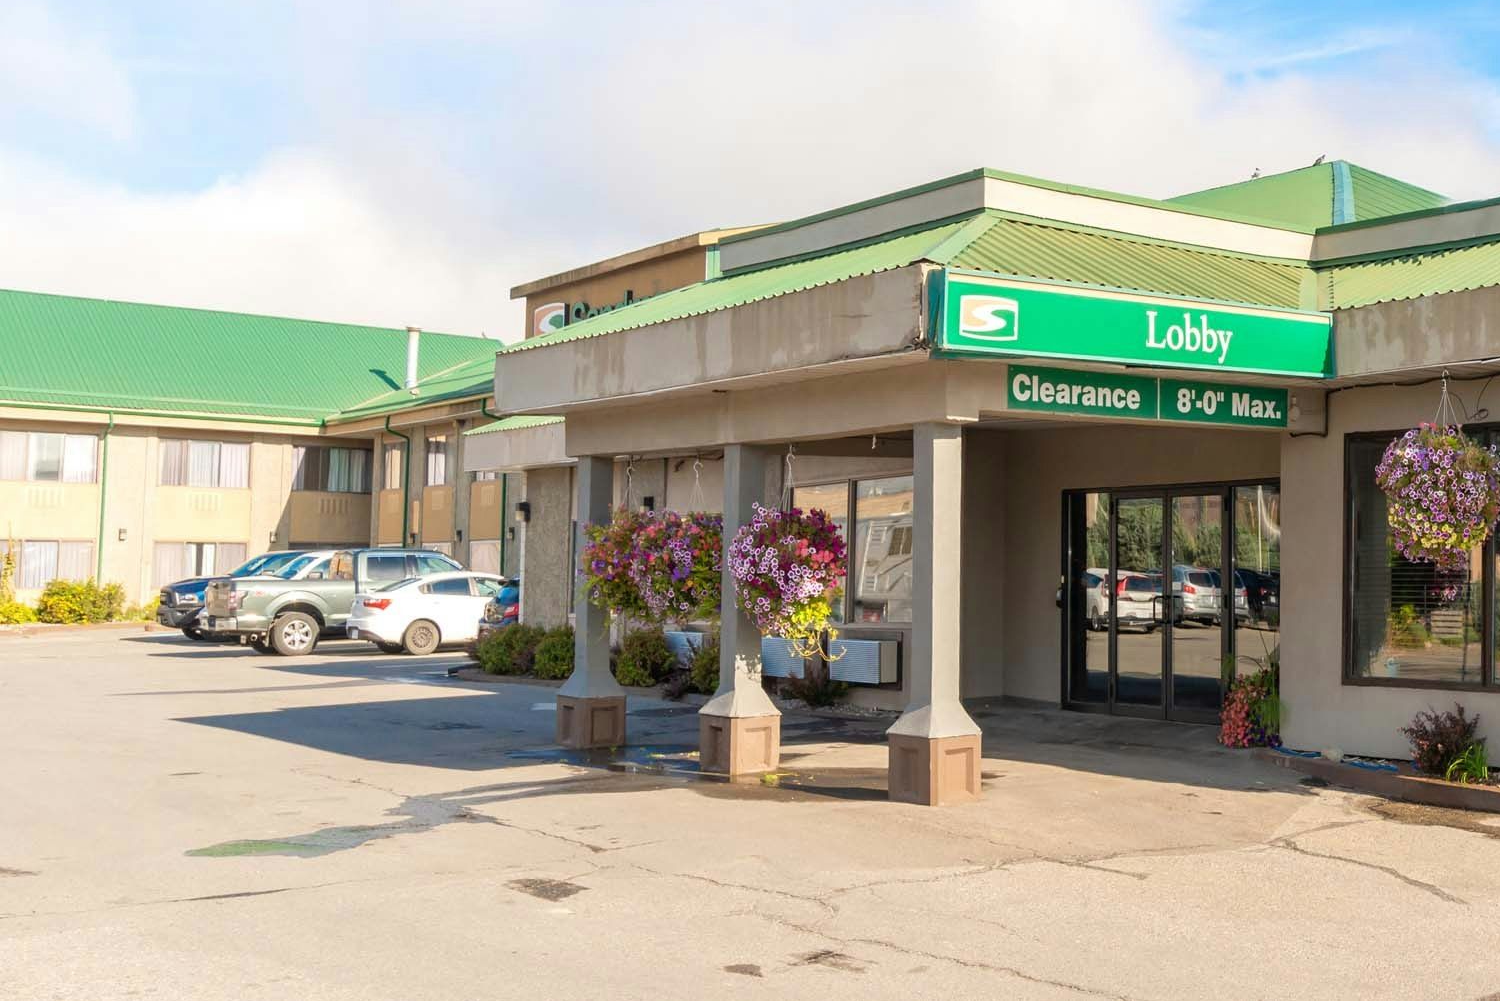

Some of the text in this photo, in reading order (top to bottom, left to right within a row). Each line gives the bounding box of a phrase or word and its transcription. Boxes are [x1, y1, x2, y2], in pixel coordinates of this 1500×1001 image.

[1145, 310, 1234, 365] Lobby
[1011, 373, 1141, 410] Clearance
[1231, 392, 1282, 420] Max.
